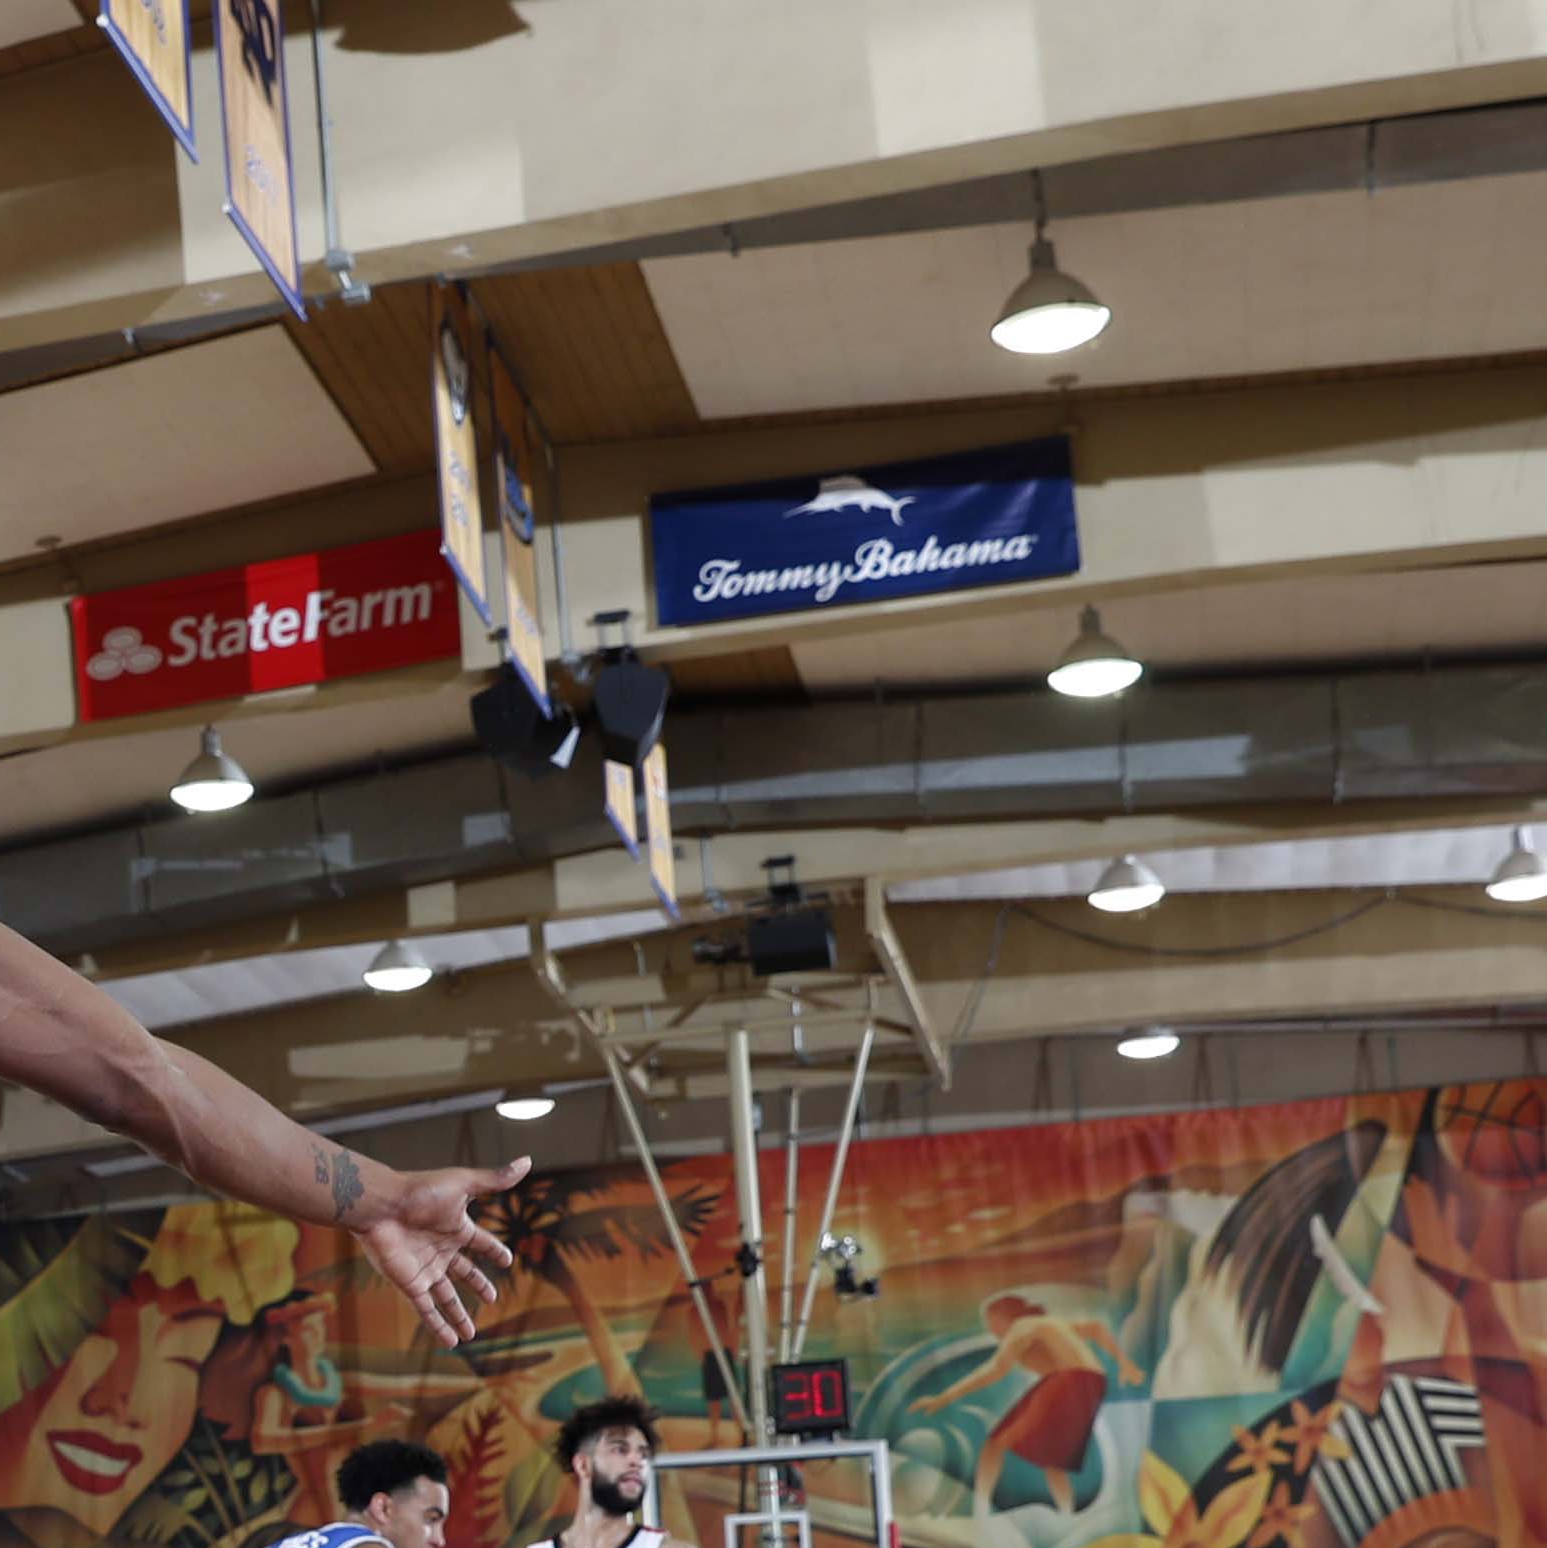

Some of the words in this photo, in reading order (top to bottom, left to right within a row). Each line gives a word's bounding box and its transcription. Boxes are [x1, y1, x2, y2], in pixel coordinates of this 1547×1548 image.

[692, 555, 850, 604] Tommy
[841, 533, 1033, 584] Bahama
[784, 1370, 842, 1420] 30
